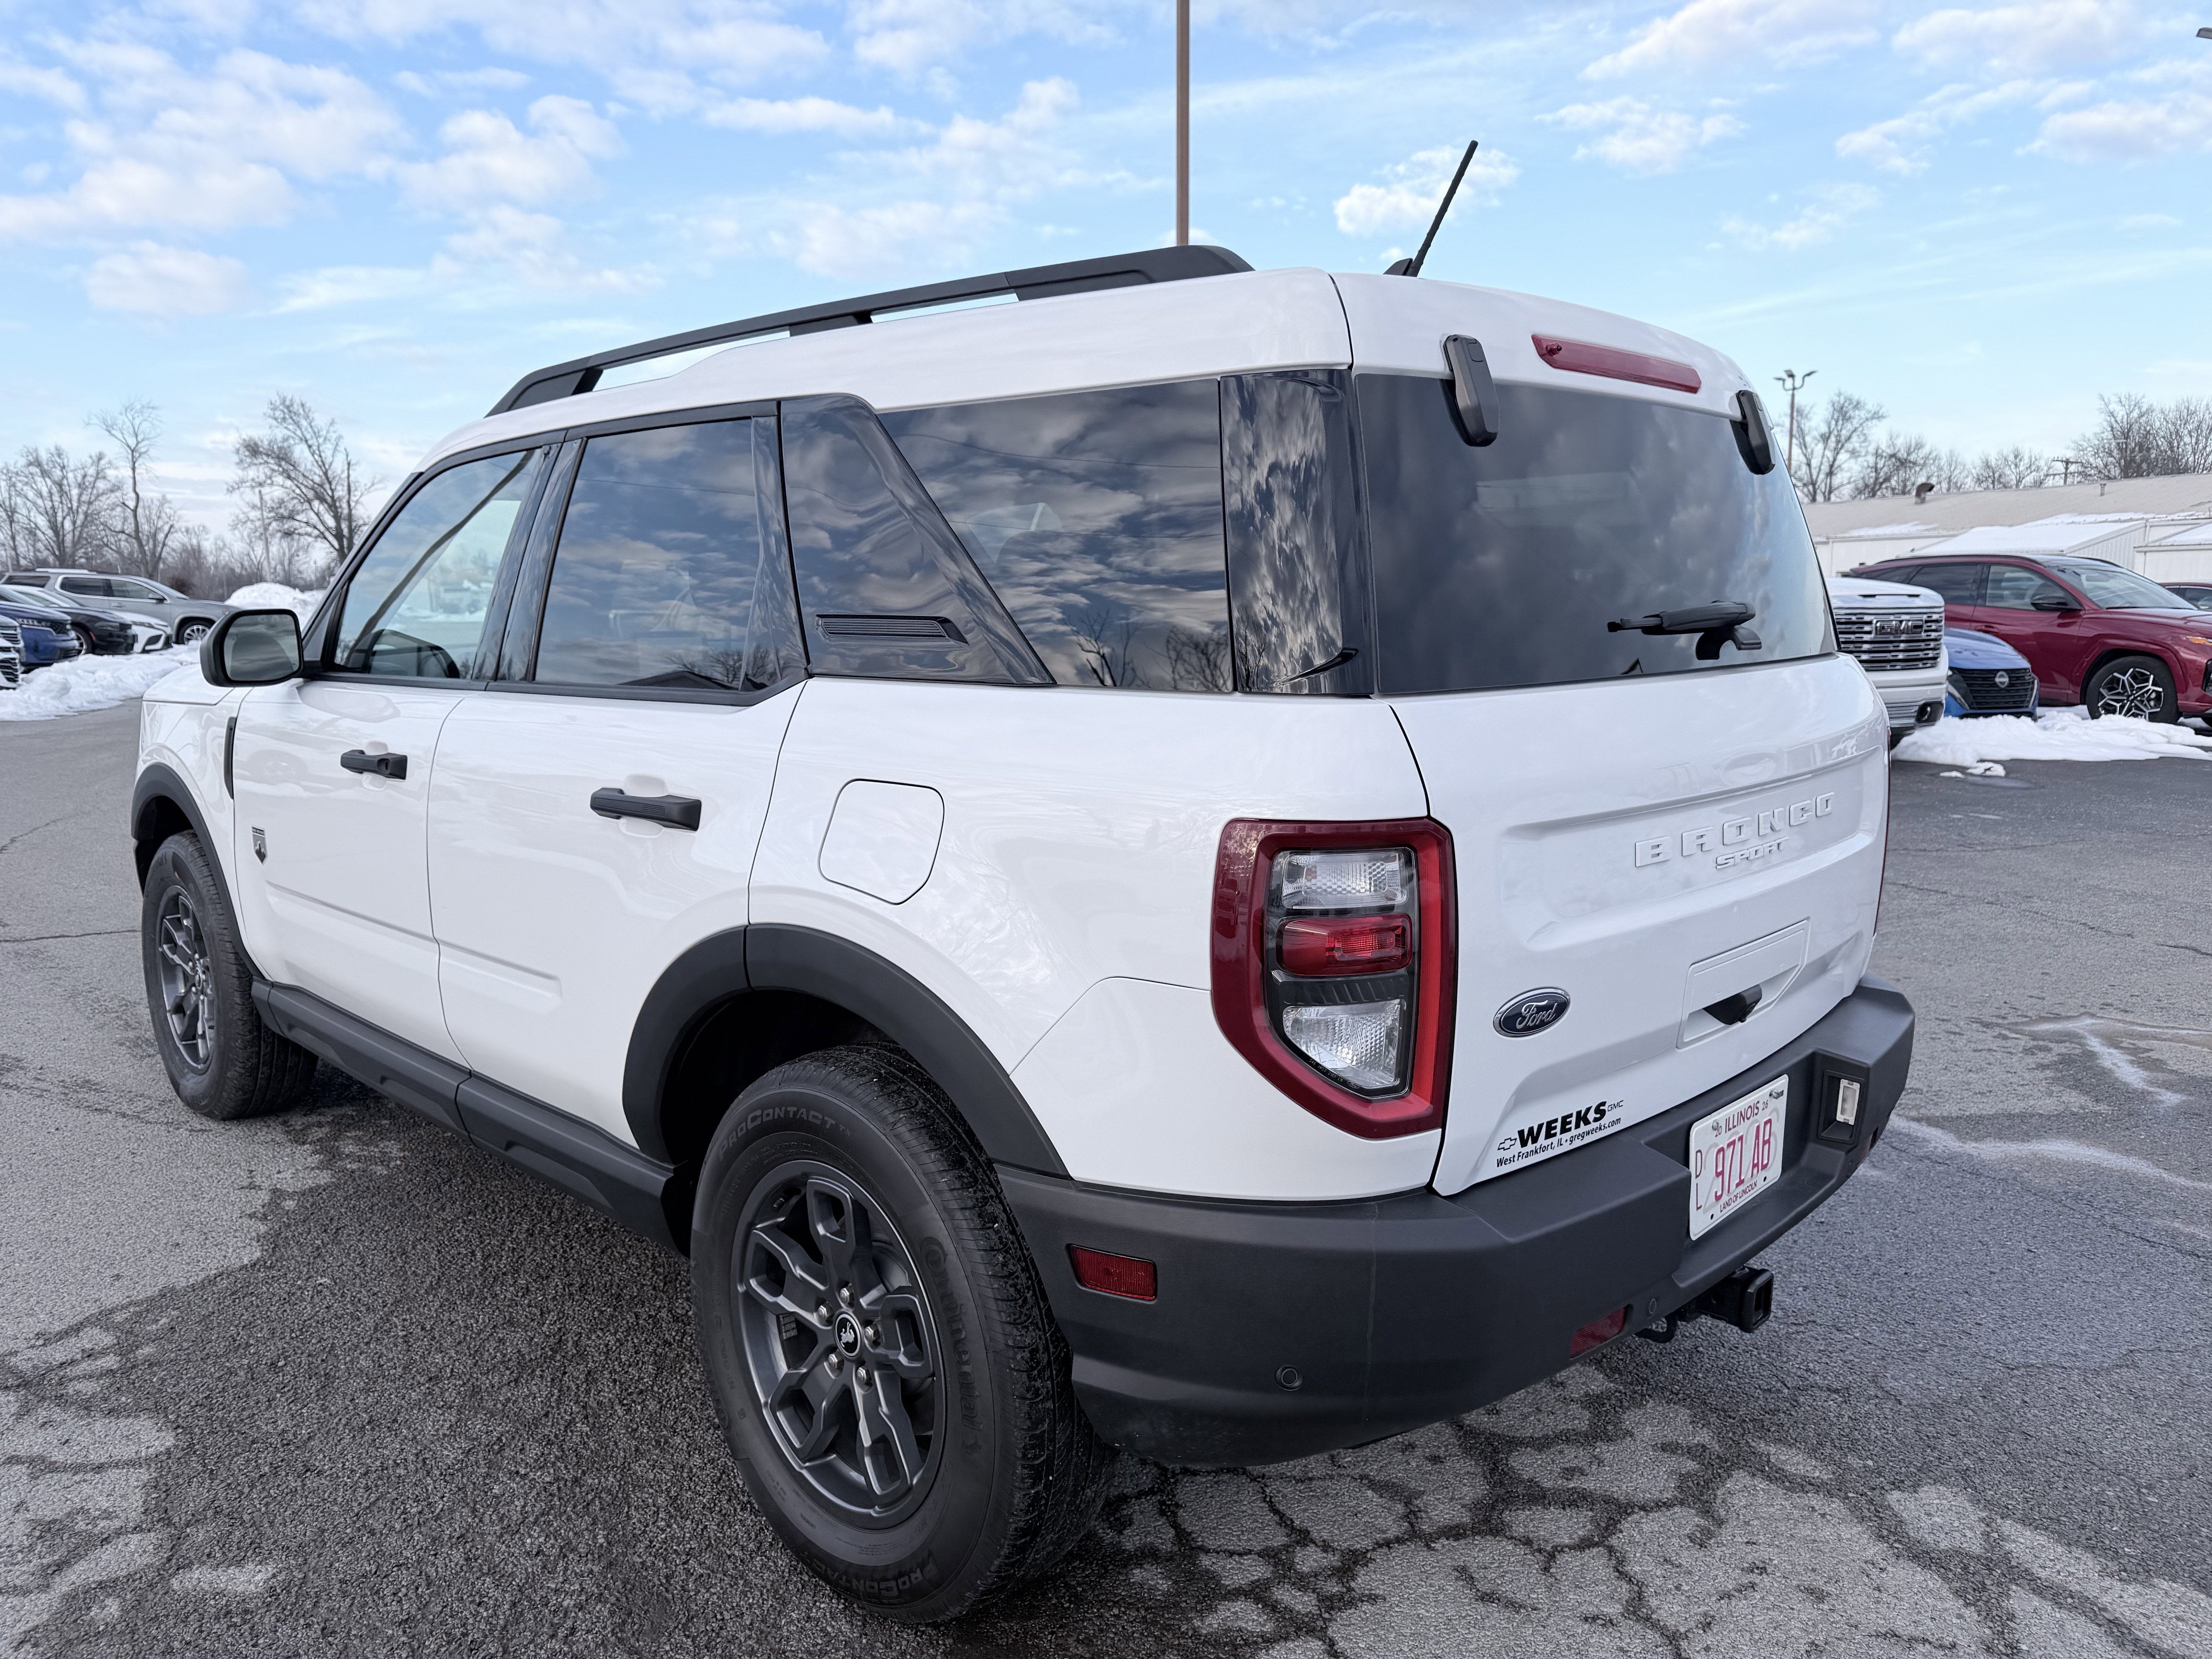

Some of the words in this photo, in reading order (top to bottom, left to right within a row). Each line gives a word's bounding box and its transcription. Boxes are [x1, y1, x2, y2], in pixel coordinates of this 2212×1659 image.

[1876, 620, 1923, 634] GMC
[1635, 792, 1835, 867] BRONCO
[1716, 836, 1790, 869] SPORT
[1516, 1000, 1558, 1029] Ford
[1517, 1101, 1607, 1148] WEEKS
[1607, 1100, 1624, 1112] GMC
[1715, 1125, 1722, 1138] 20
[1724, 1100, 1760, 1133] ILLINOIS
[1762, 1099, 1768, 1111] 26
[1496, 1154, 1515, 1168] West
[1517, 1142, 1555, 1161] Frankfort,
[1557, 1137, 1563, 1147] IL
[1569, 1117, 1621, 1145] gregweeks.com
[1714, 1134, 1745, 1202] 971
[1750, 1118, 1772, 1178] AB
[1720, 1197, 1732, 1213] LAND
[1733, 1191, 1739, 1203] OF
[1739, 1180, 1757, 1199] LINCOLN
